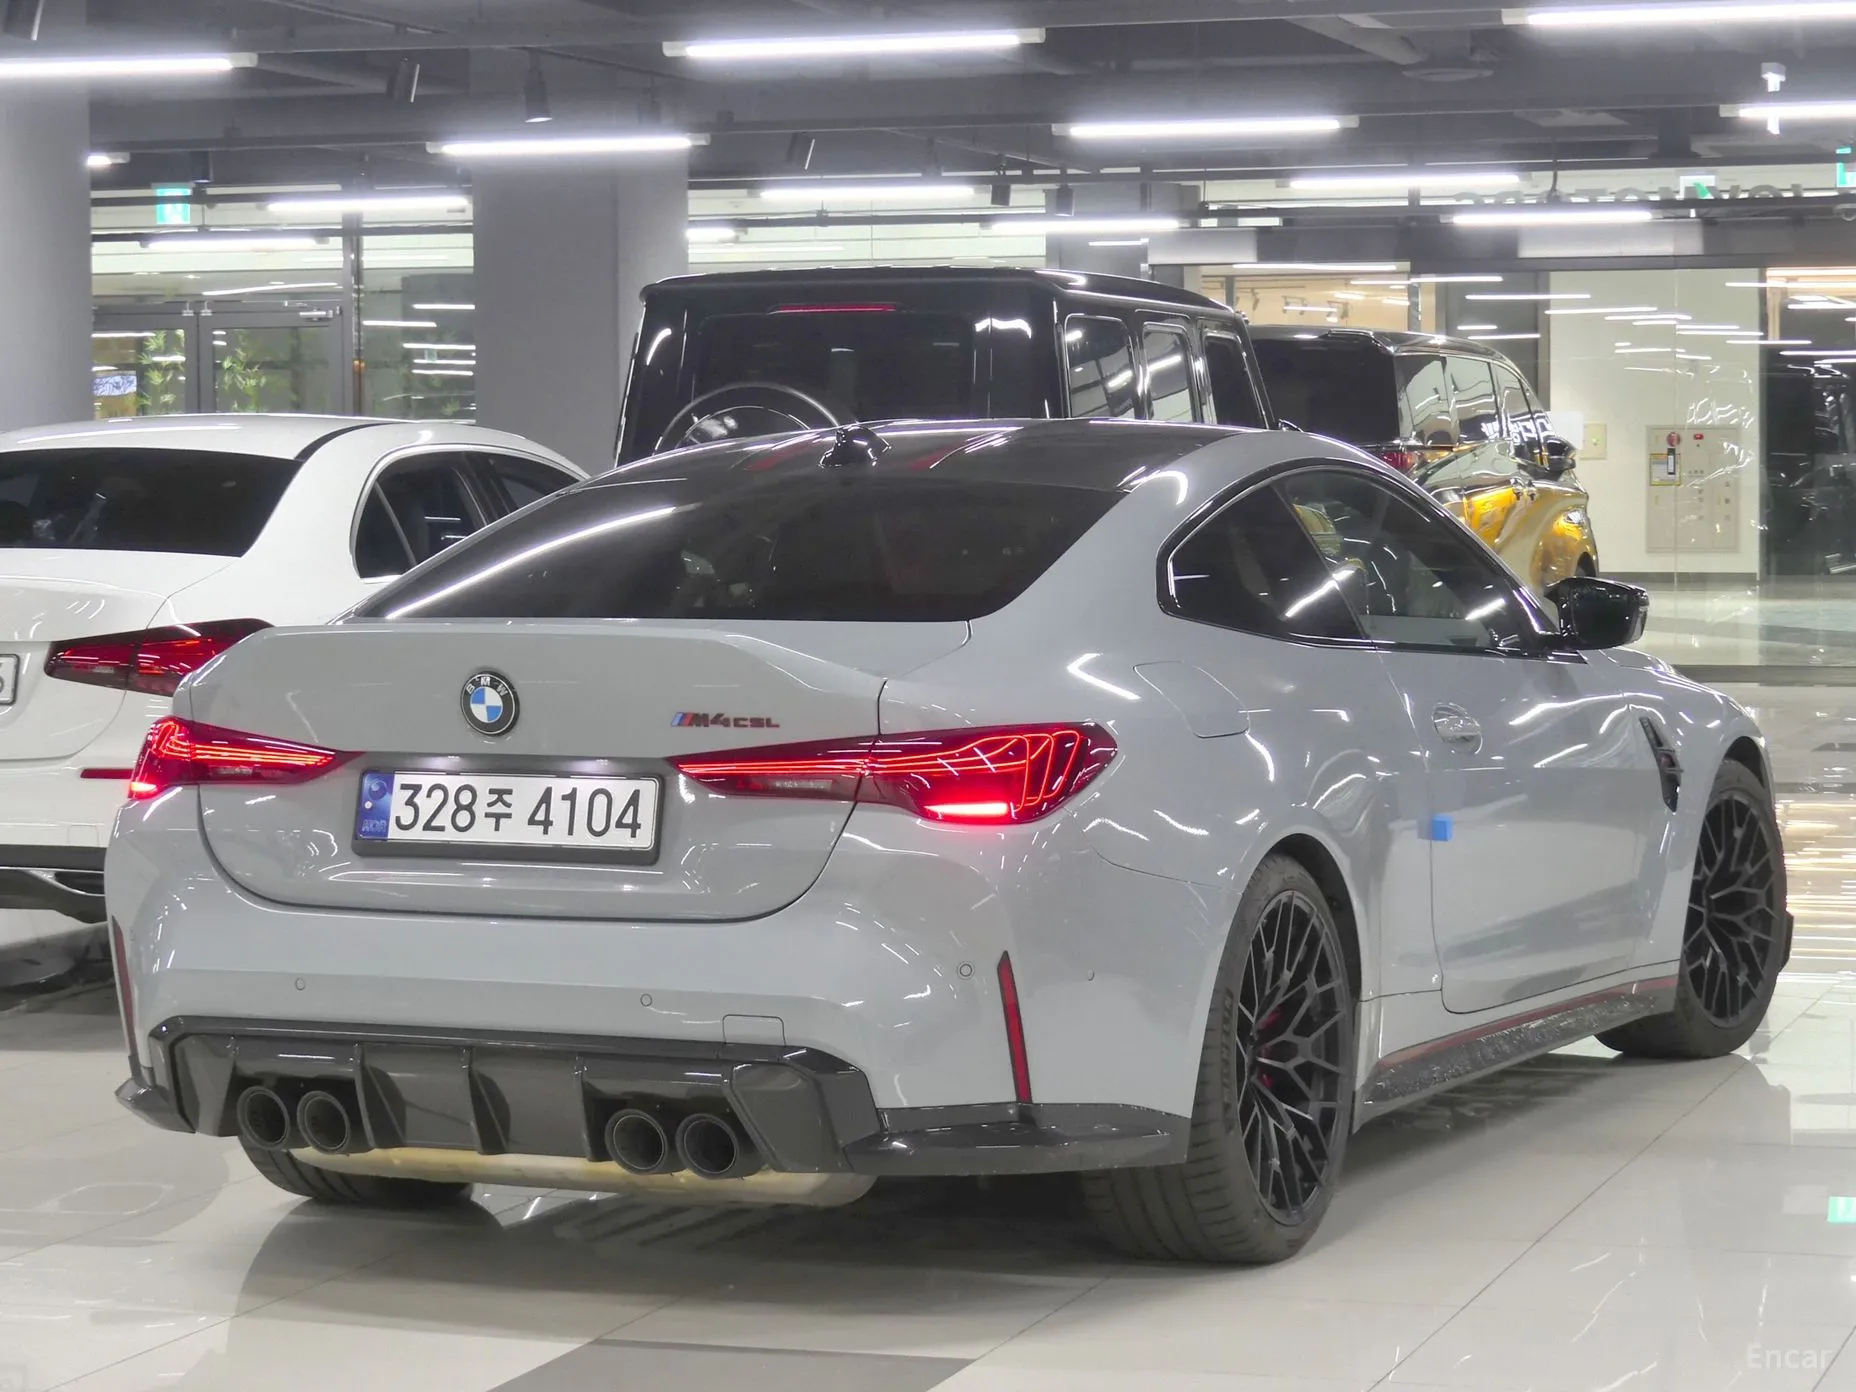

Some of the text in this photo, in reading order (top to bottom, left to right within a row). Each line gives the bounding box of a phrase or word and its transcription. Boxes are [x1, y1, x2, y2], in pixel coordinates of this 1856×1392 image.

[466, 676, 509, 696] BMW
[733, 717, 780, 728] CSL
[395, 783, 642, 838] 328주 4104
